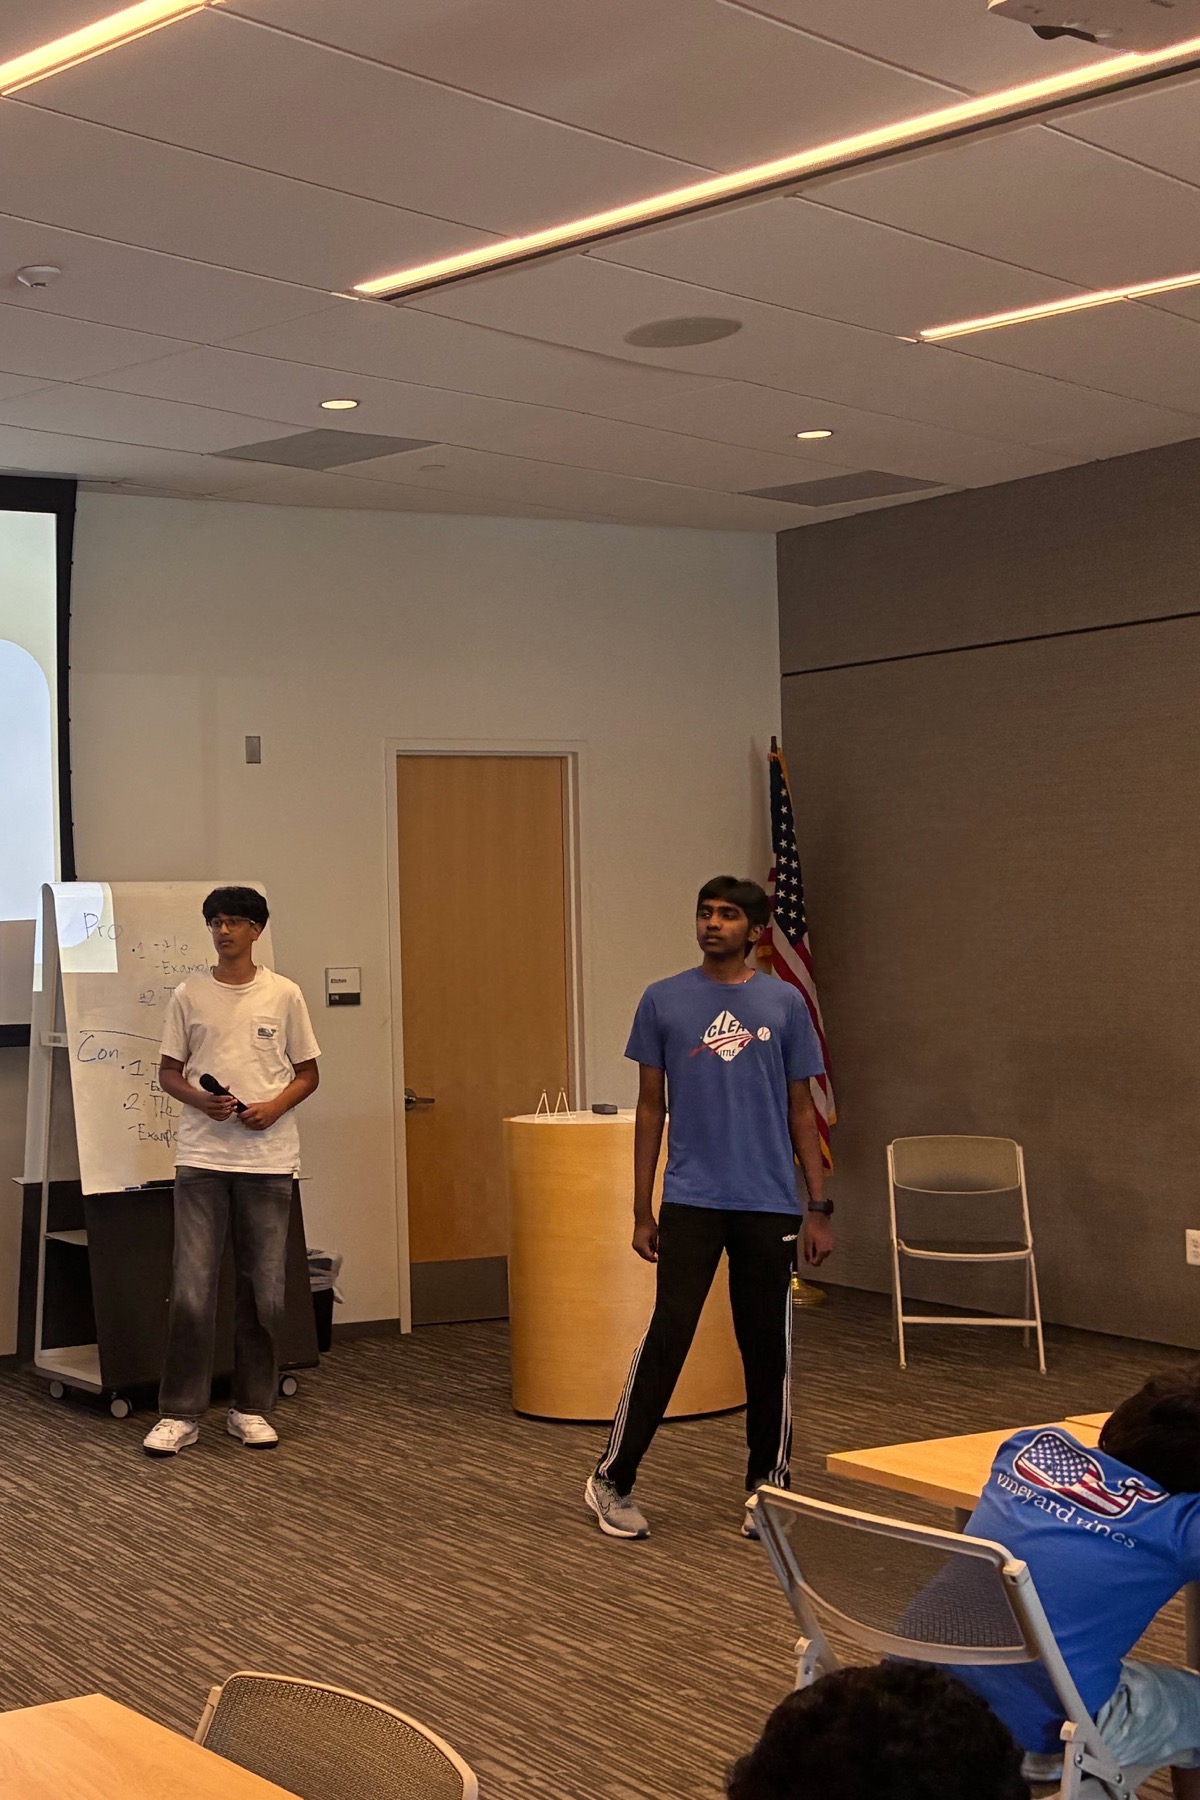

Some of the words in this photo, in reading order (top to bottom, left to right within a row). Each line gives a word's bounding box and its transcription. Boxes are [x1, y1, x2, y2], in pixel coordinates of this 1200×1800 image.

[83, 912, 124, 940] Pro
[77, 1034, 119, 1062] Con
[997, 1473, 1075, 1523] vineyard
